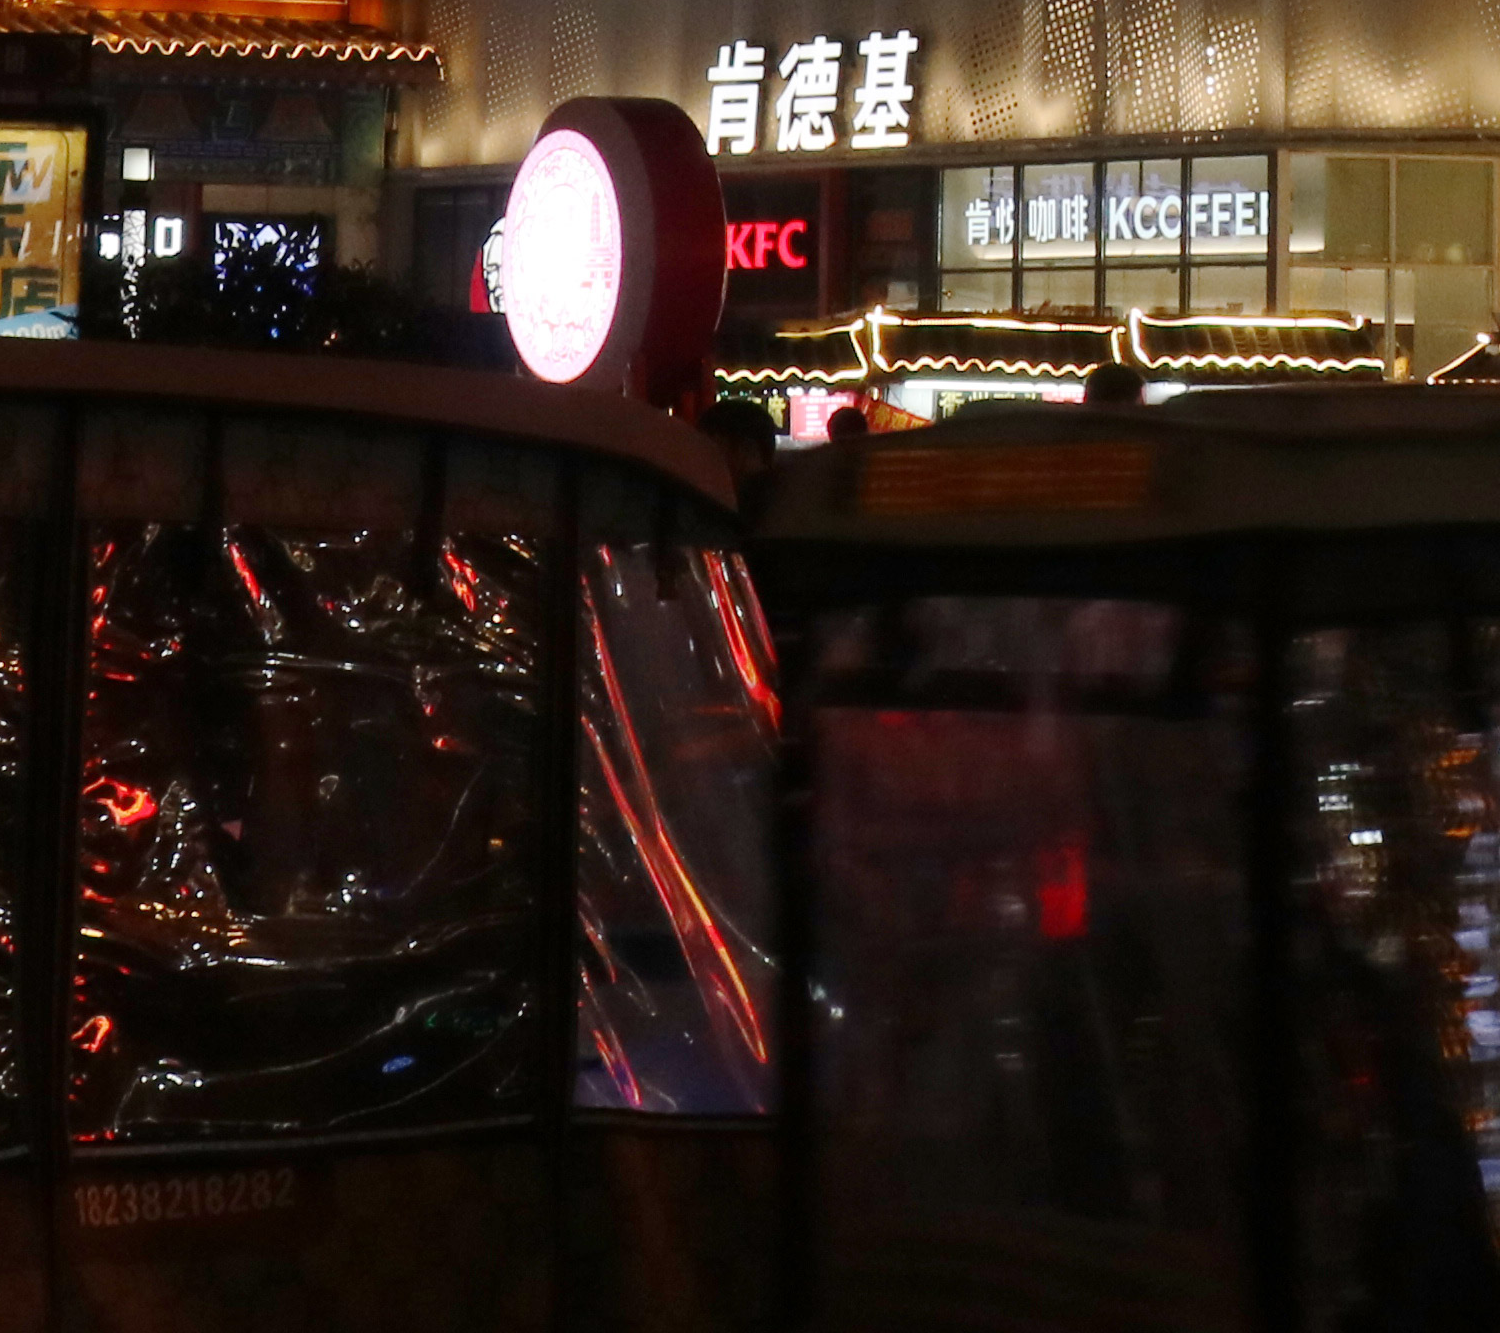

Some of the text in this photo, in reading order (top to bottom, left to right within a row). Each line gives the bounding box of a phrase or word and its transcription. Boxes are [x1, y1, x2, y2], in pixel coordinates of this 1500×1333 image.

[706, 28, 919, 157] 肯德基
[726, 219, 807, 270] KFC
